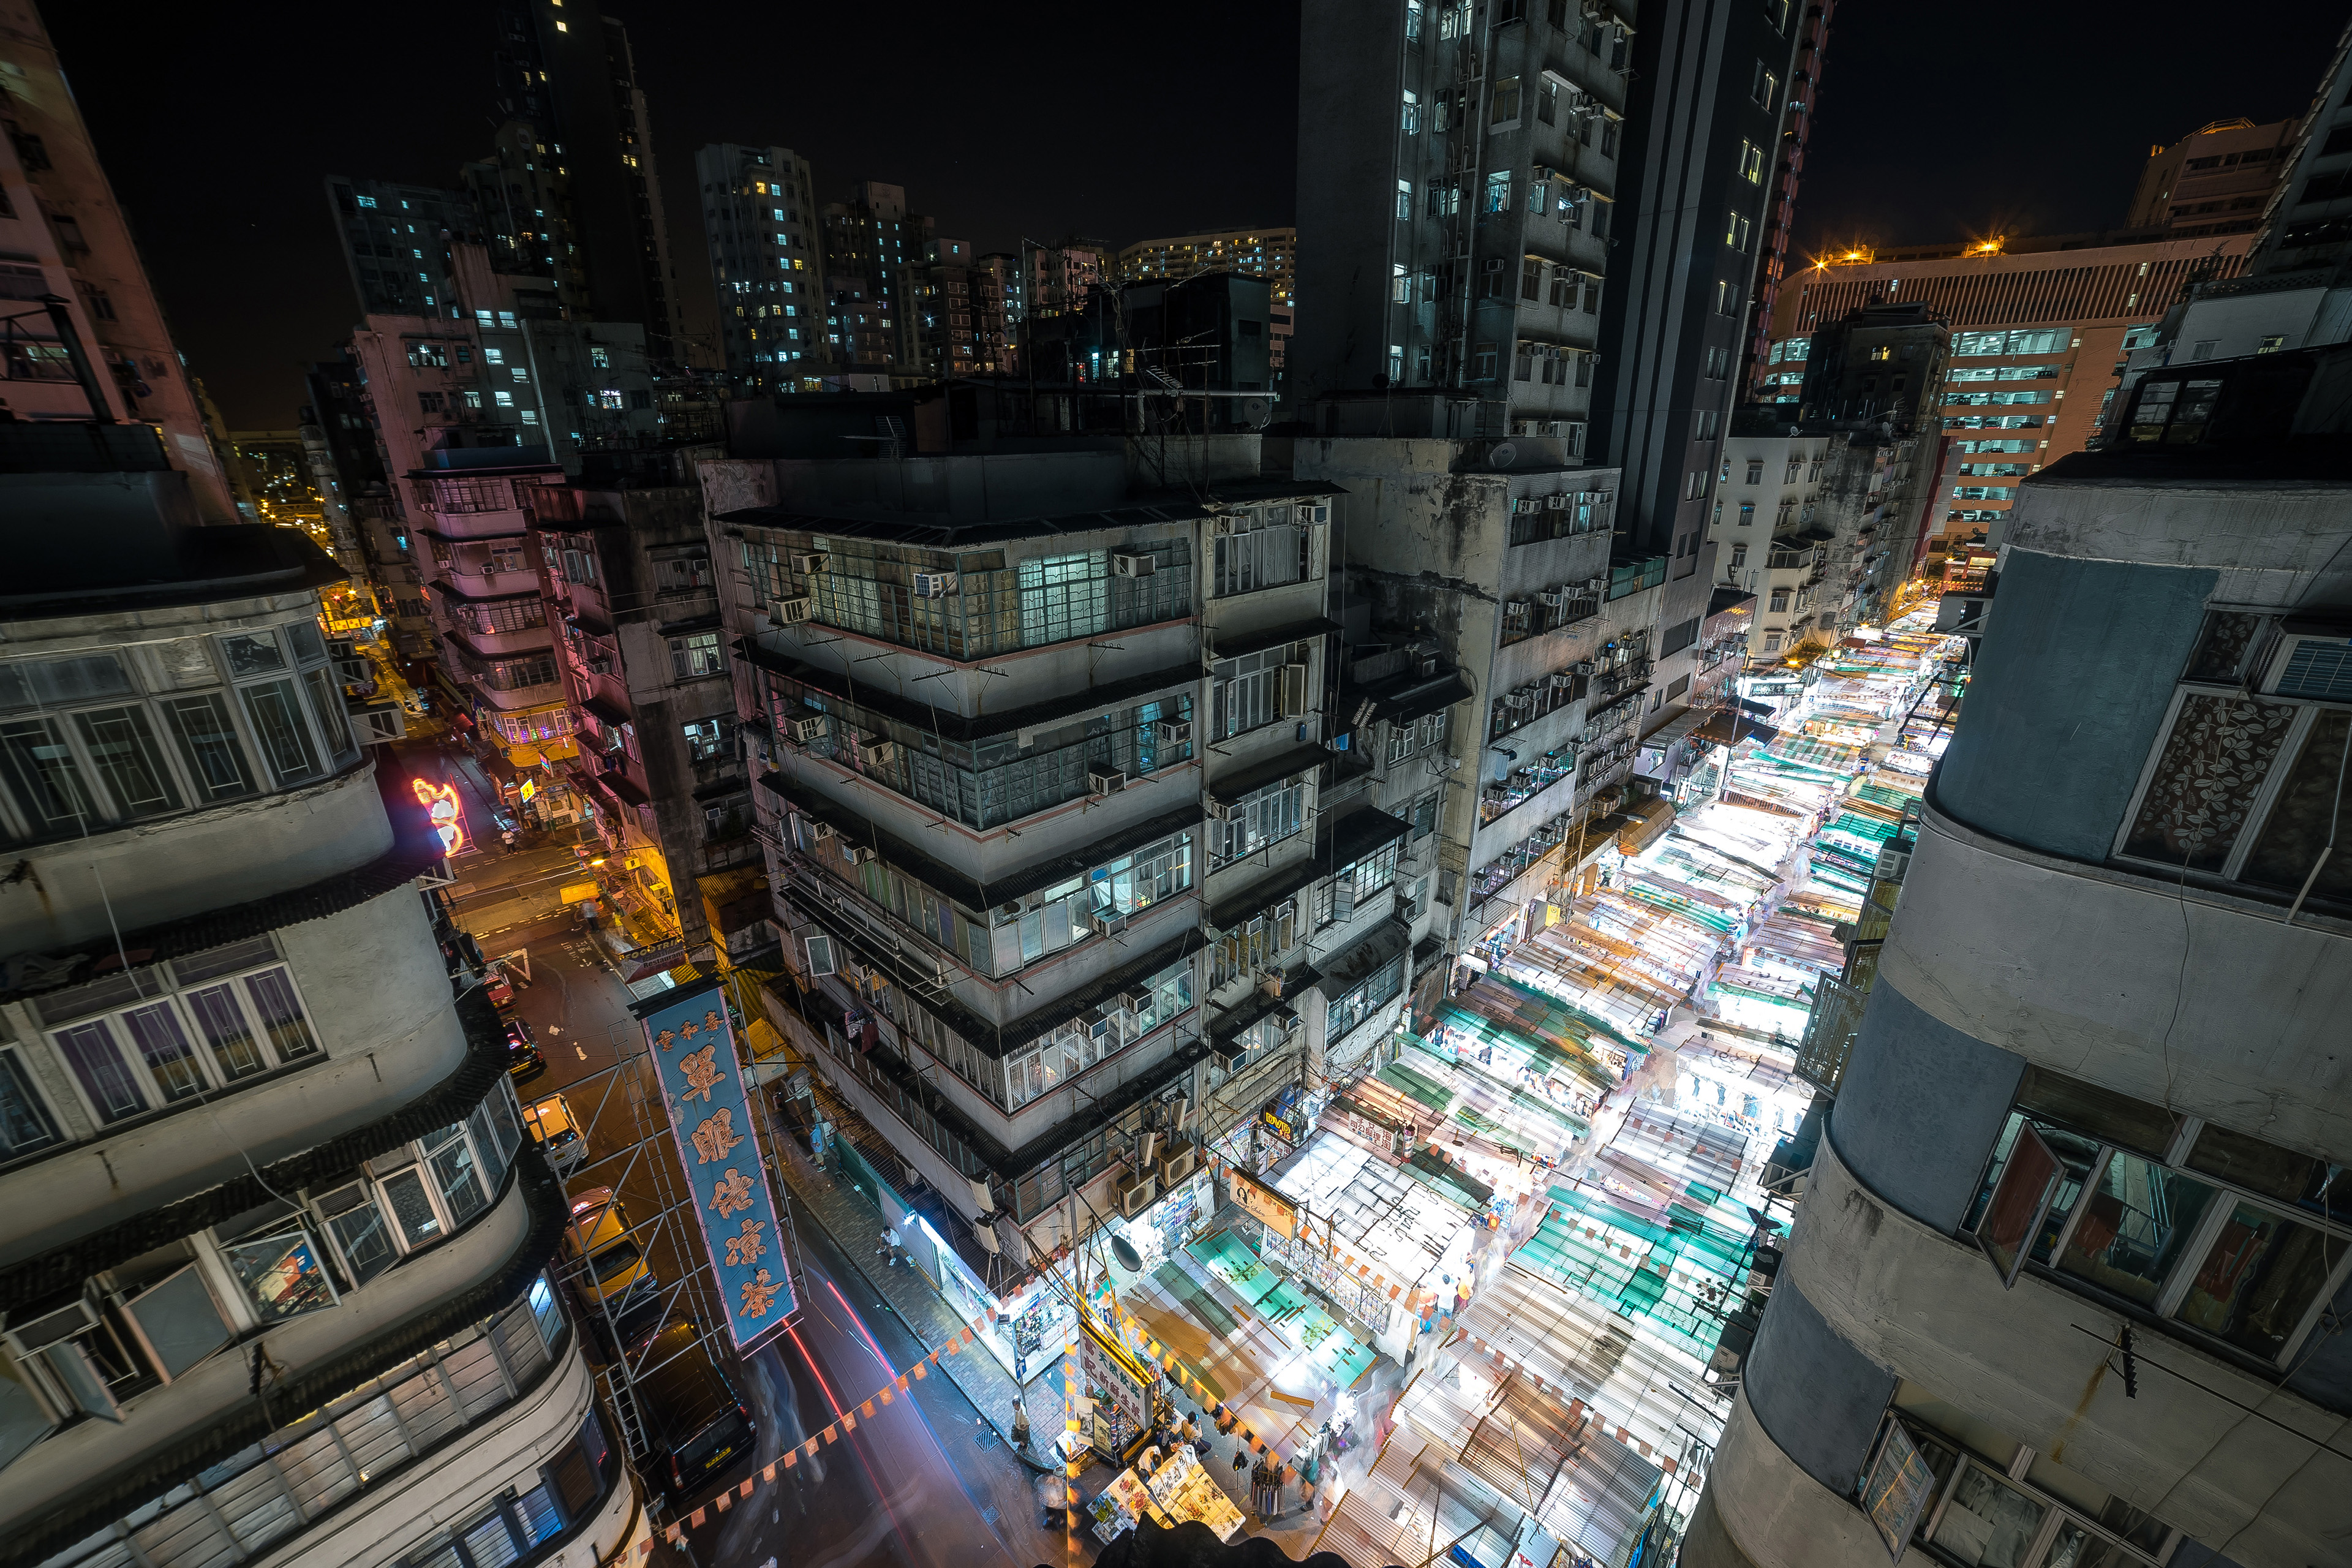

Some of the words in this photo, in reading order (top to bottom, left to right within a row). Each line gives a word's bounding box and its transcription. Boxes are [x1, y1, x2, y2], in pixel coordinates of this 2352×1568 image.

[643, 952, 684, 968] Restaurant
[1266, 1112, 1291, 1134] DVD
[1350, 1120, 1381, 1142] 理髮公司
[1279, 1129, 1291, 1140] $10
[1233, 1197, 1250, 1210] Image
[1251, 1204, 1265, 1216] Salon
[1083, 1335, 1098, 1379] 富記
[1098, 1351, 1140, 1400] 天然飲品
